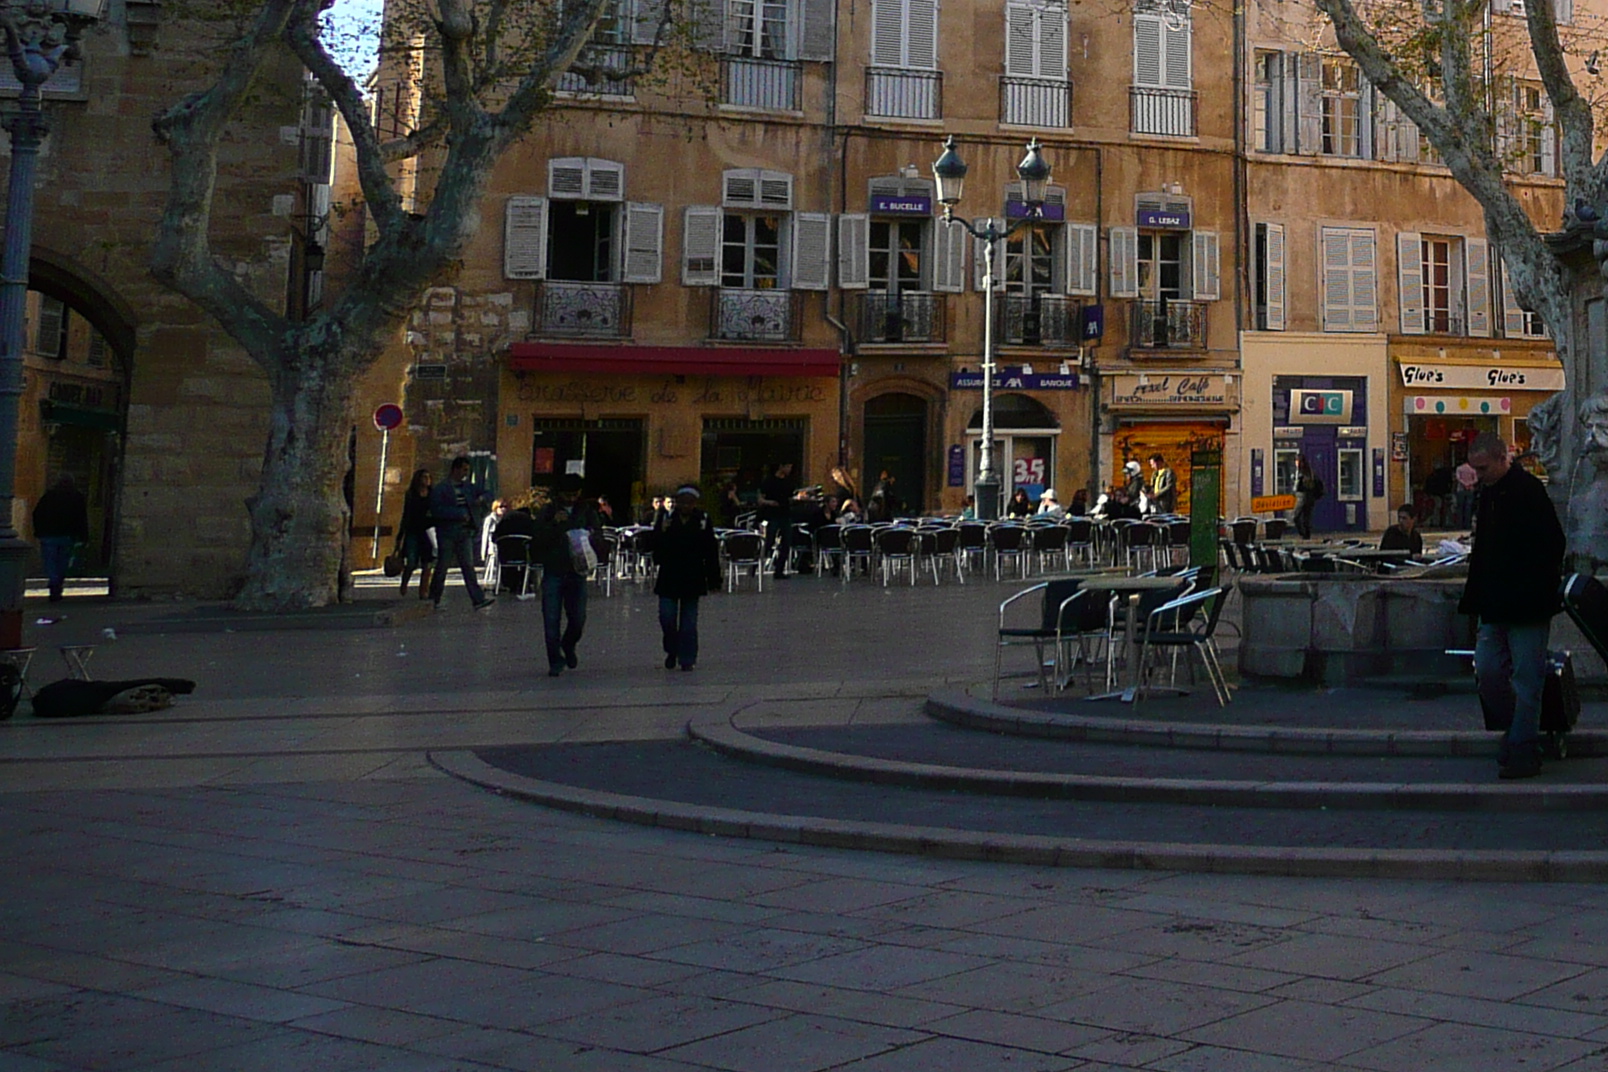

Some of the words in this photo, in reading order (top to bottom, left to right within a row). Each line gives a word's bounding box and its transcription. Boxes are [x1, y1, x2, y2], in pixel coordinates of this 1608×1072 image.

[652, 379, 677, 404] de
[692, 378, 724, 403] la
[1040, 379, 1073, 388] BANQUE
[1304, 396, 1339, 411] CIC
